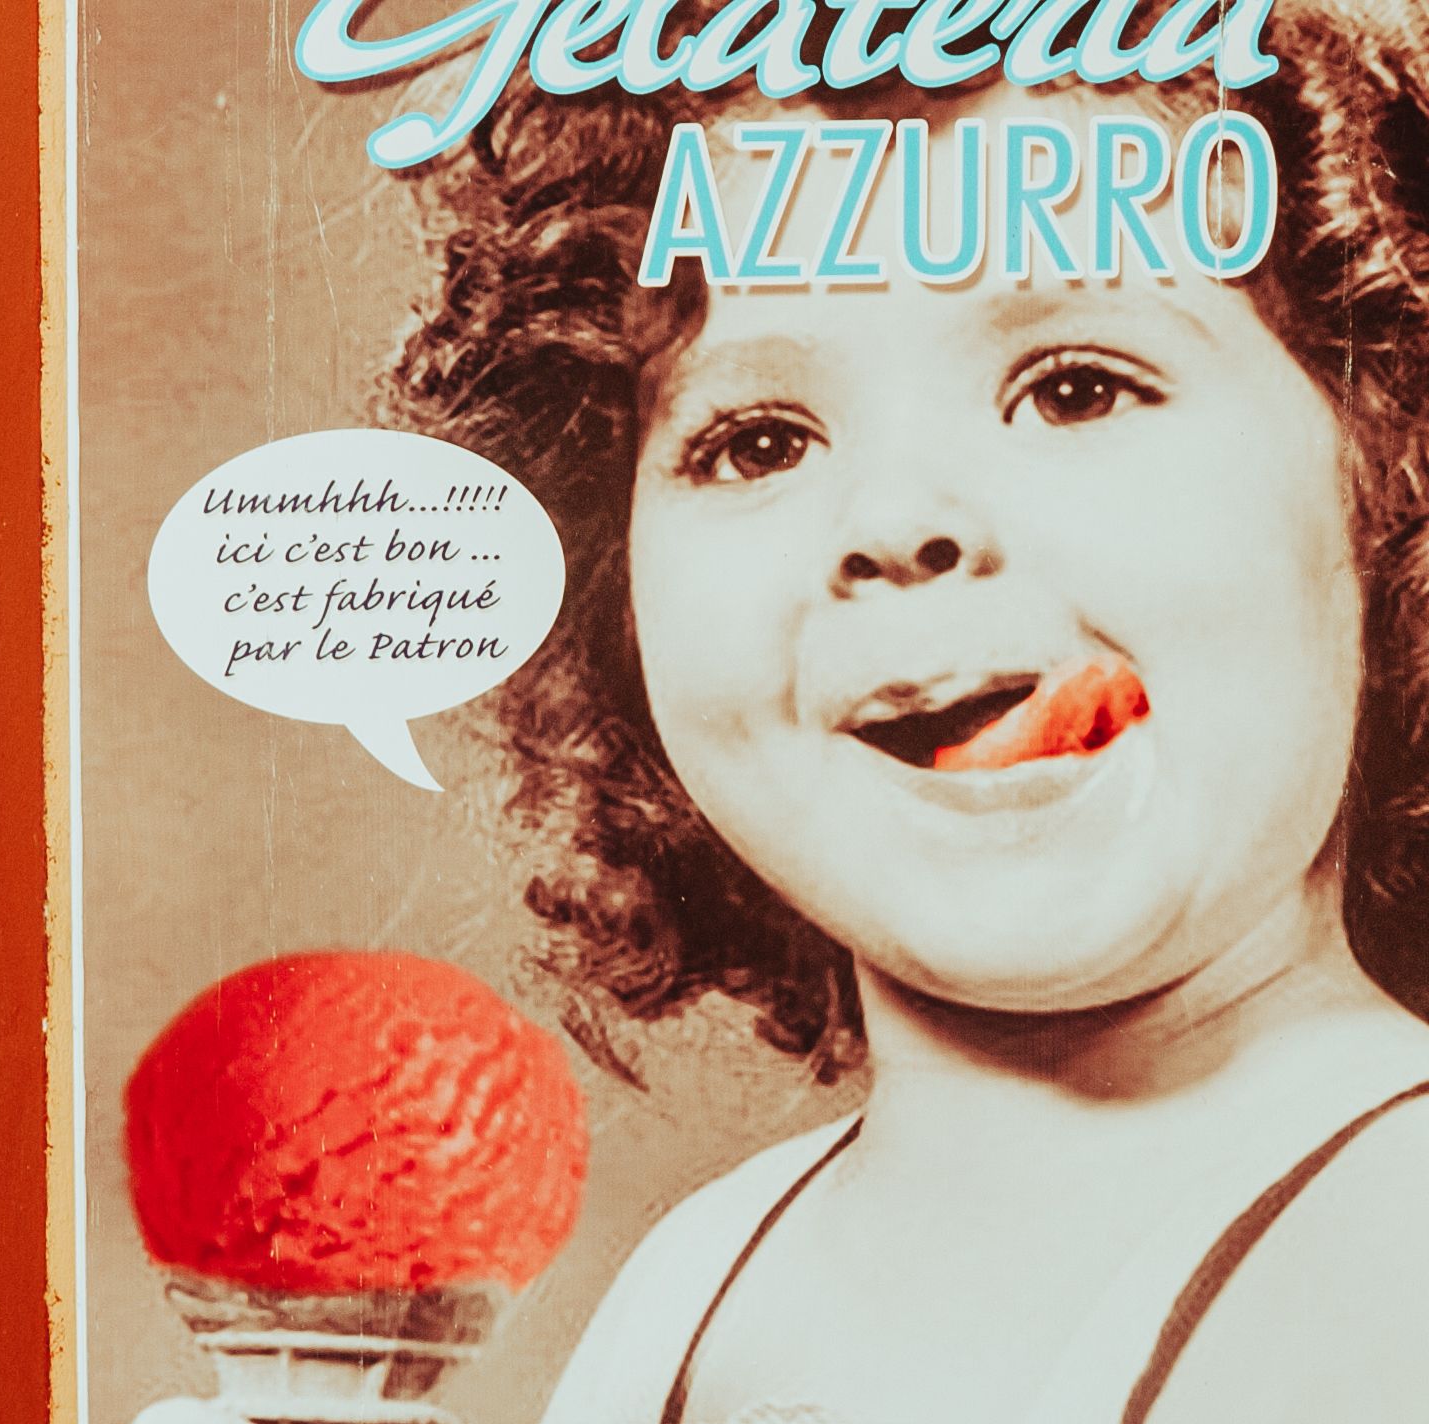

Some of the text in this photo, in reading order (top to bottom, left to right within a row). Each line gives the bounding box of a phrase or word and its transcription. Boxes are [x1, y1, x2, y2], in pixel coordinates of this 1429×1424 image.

[295, 0, 1280, 169] Gelateria
[639, 110, 1280, 287] AZZURRO
[216, 532, 274, 563] ici
[285, 533, 375, 563] c'est
[385, 528, 461, 562] bon
[224, 578, 501, 630] c'est fabriqué
[224, 628, 509, 677] par le Patron
